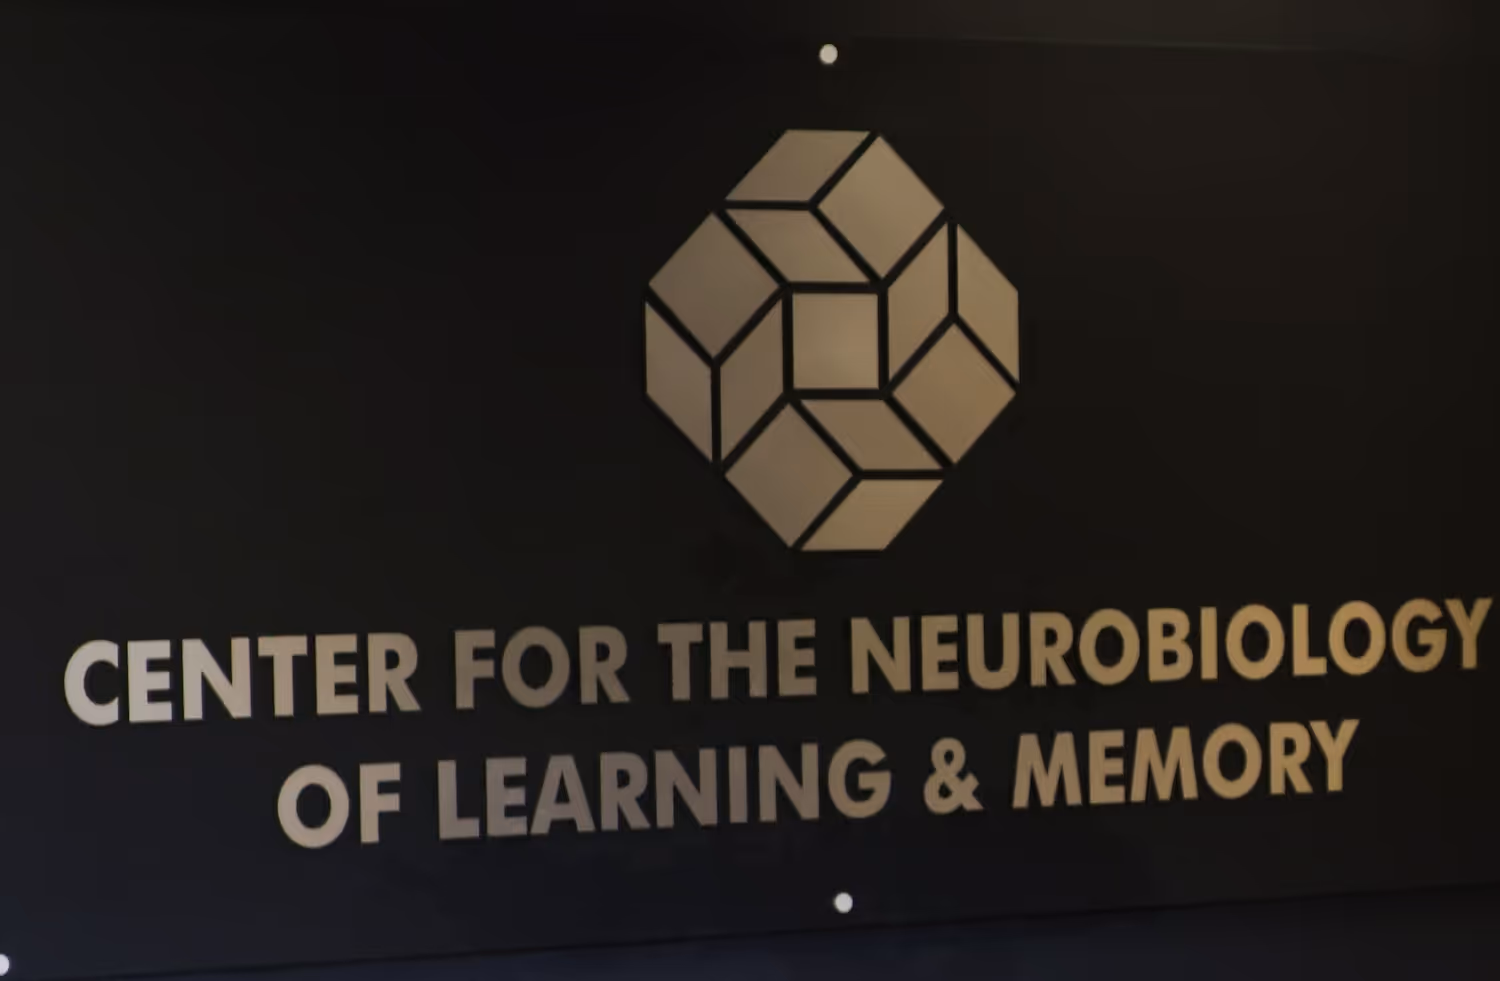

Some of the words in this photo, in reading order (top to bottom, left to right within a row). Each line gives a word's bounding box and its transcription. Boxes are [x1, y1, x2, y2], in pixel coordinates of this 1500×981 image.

[64, 631, 421, 726] CENTER
[455, 626, 629, 708] FOR
[658, 619, 817, 701] THE
[850, 598, 1492, 695] NEUROBIOLOGY
[278, 762, 401, 848] OF
[438, 740, 892, 840] LEARNING
[923, 737, 983, 814] &
[1012, 719, 1359, 809] MEMORY
